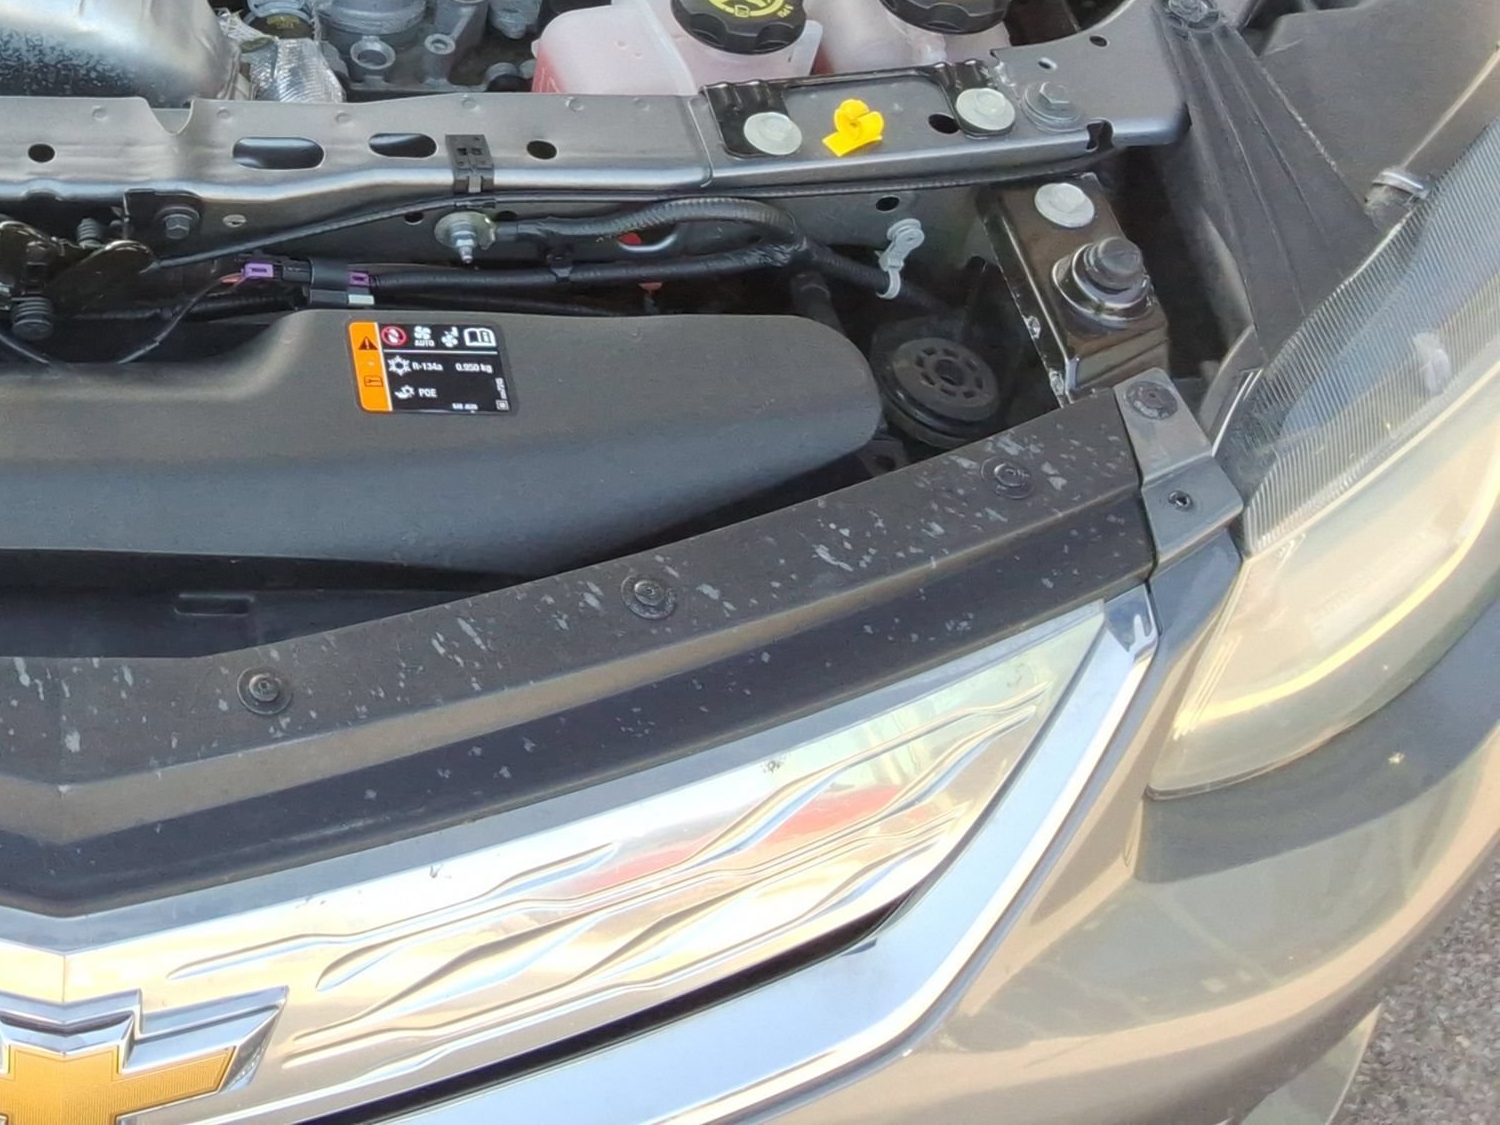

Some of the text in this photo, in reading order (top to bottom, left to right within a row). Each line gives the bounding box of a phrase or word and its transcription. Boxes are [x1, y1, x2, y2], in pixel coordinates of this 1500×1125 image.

[414, 338, 436, 348] AUTO
[480, 363, 493, 374] kg
[418, 387, 438, 398] POE
